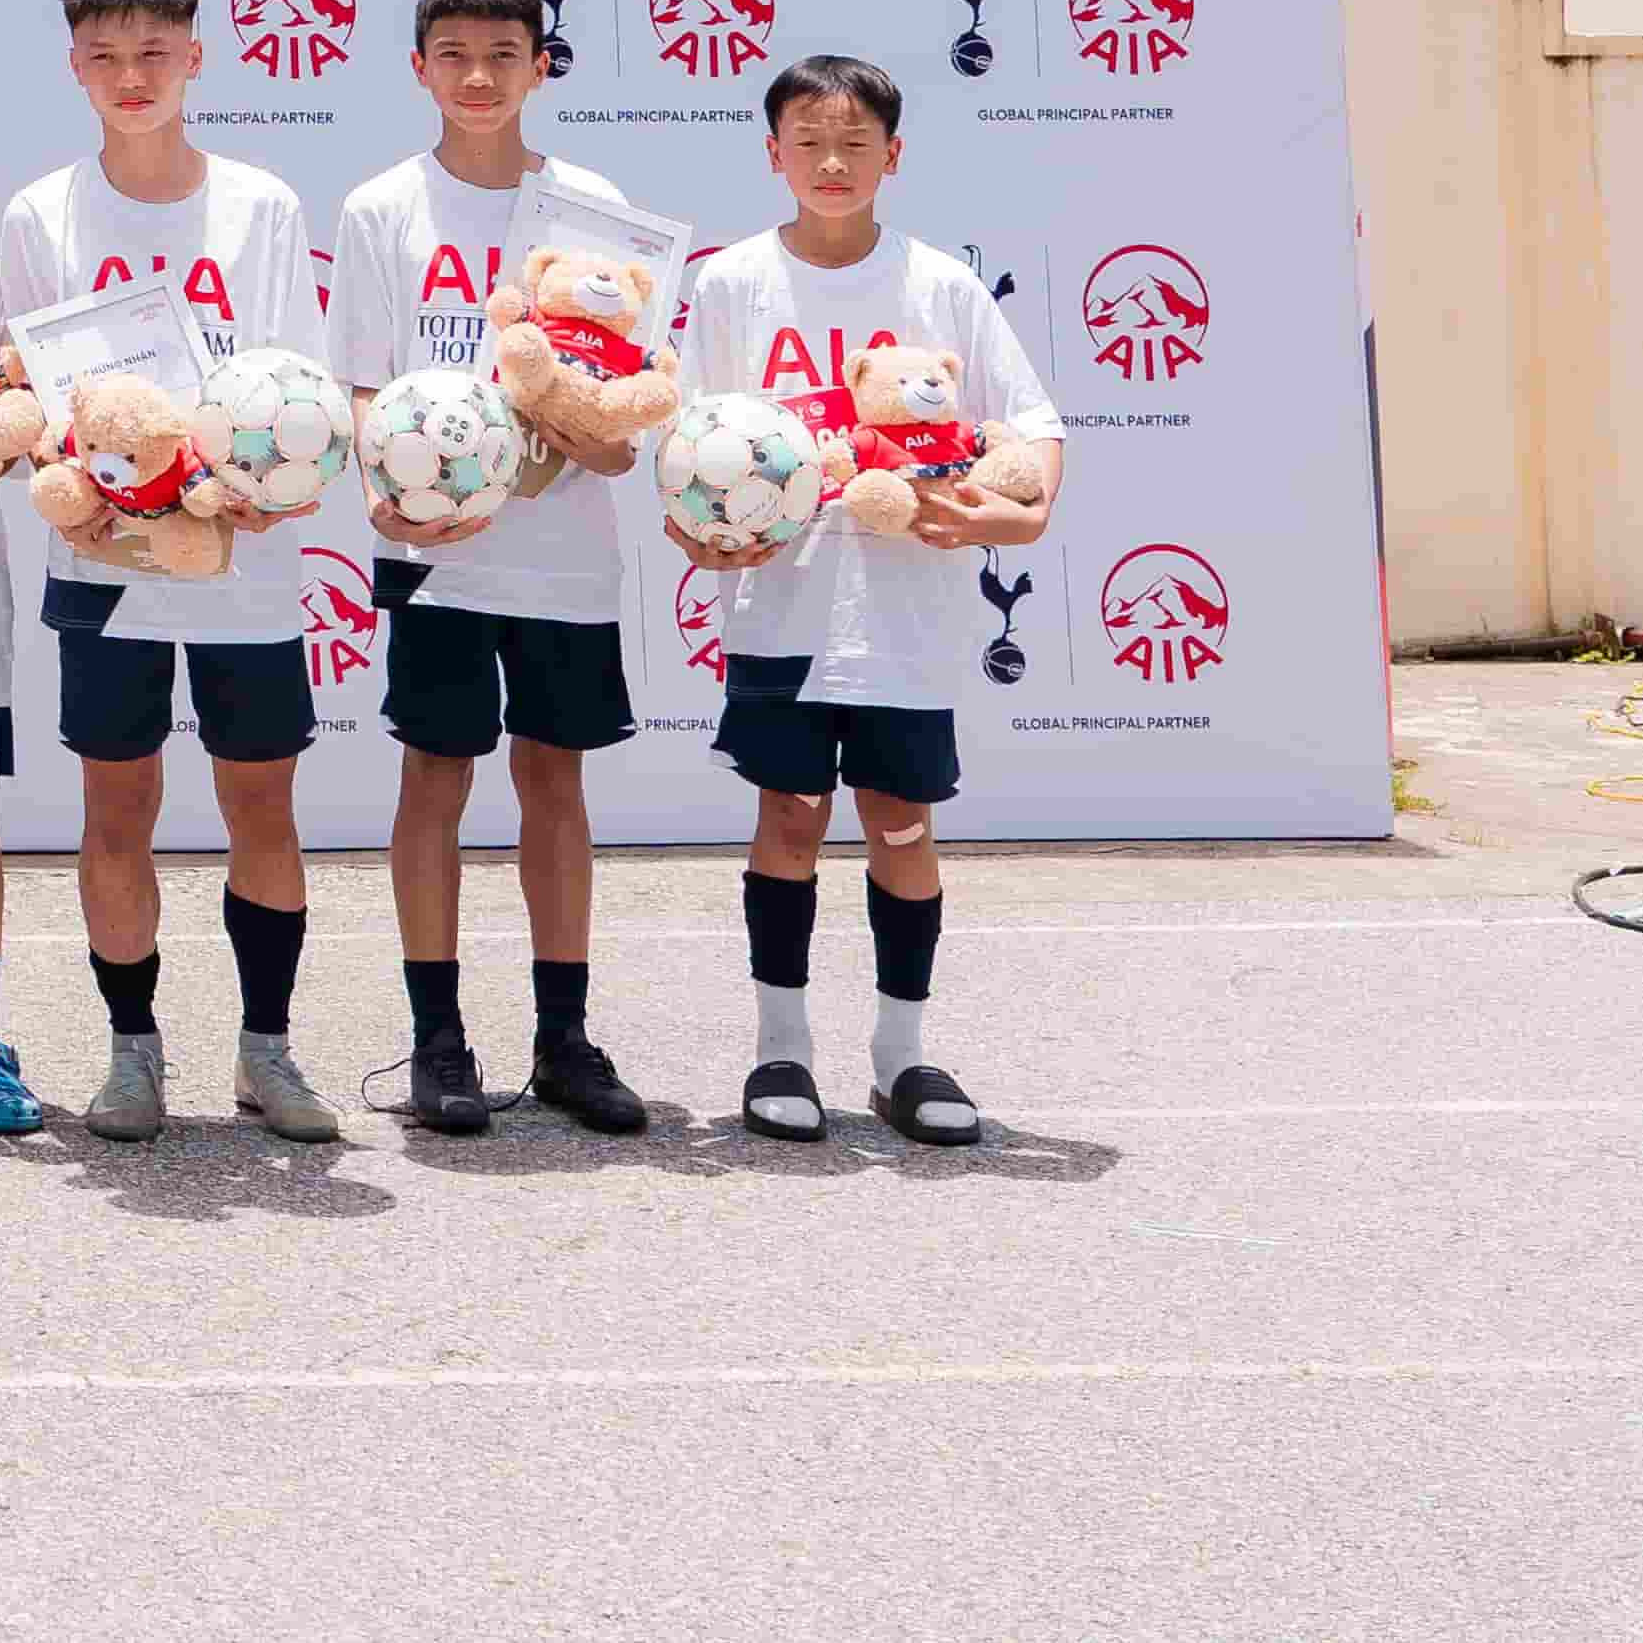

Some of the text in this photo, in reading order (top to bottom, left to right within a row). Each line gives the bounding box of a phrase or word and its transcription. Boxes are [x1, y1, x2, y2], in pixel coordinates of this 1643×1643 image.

[240, 33, 349, 80] AIA
[660, 30, 768, 78] AIA
[1080, 28, 1189, 75] AIA
[197, 111, 271, 125] PRINCIPAL
[271, 111, 335, 125] PARTNER
[557, 108, 754, 123] GLOBAL PRINCIPAL PARTNER
[977, 108, 1173, 121] GLOBAL PRINCIPAL PARTNER
[573, 330, 604, 349] AIA
[1095, 335, 1204, 382] AIA
[1060, 414, 1192, 428] RINCIPAL PARTNER
[905, 433, 937, 450] AIA
[1113, 635, 1223, 683] AIA
[644, 718, 715, 732] PRINCIPAL
[1011, 716, 1211, 731] GLOBAL PRINCIPAL PARTNER
